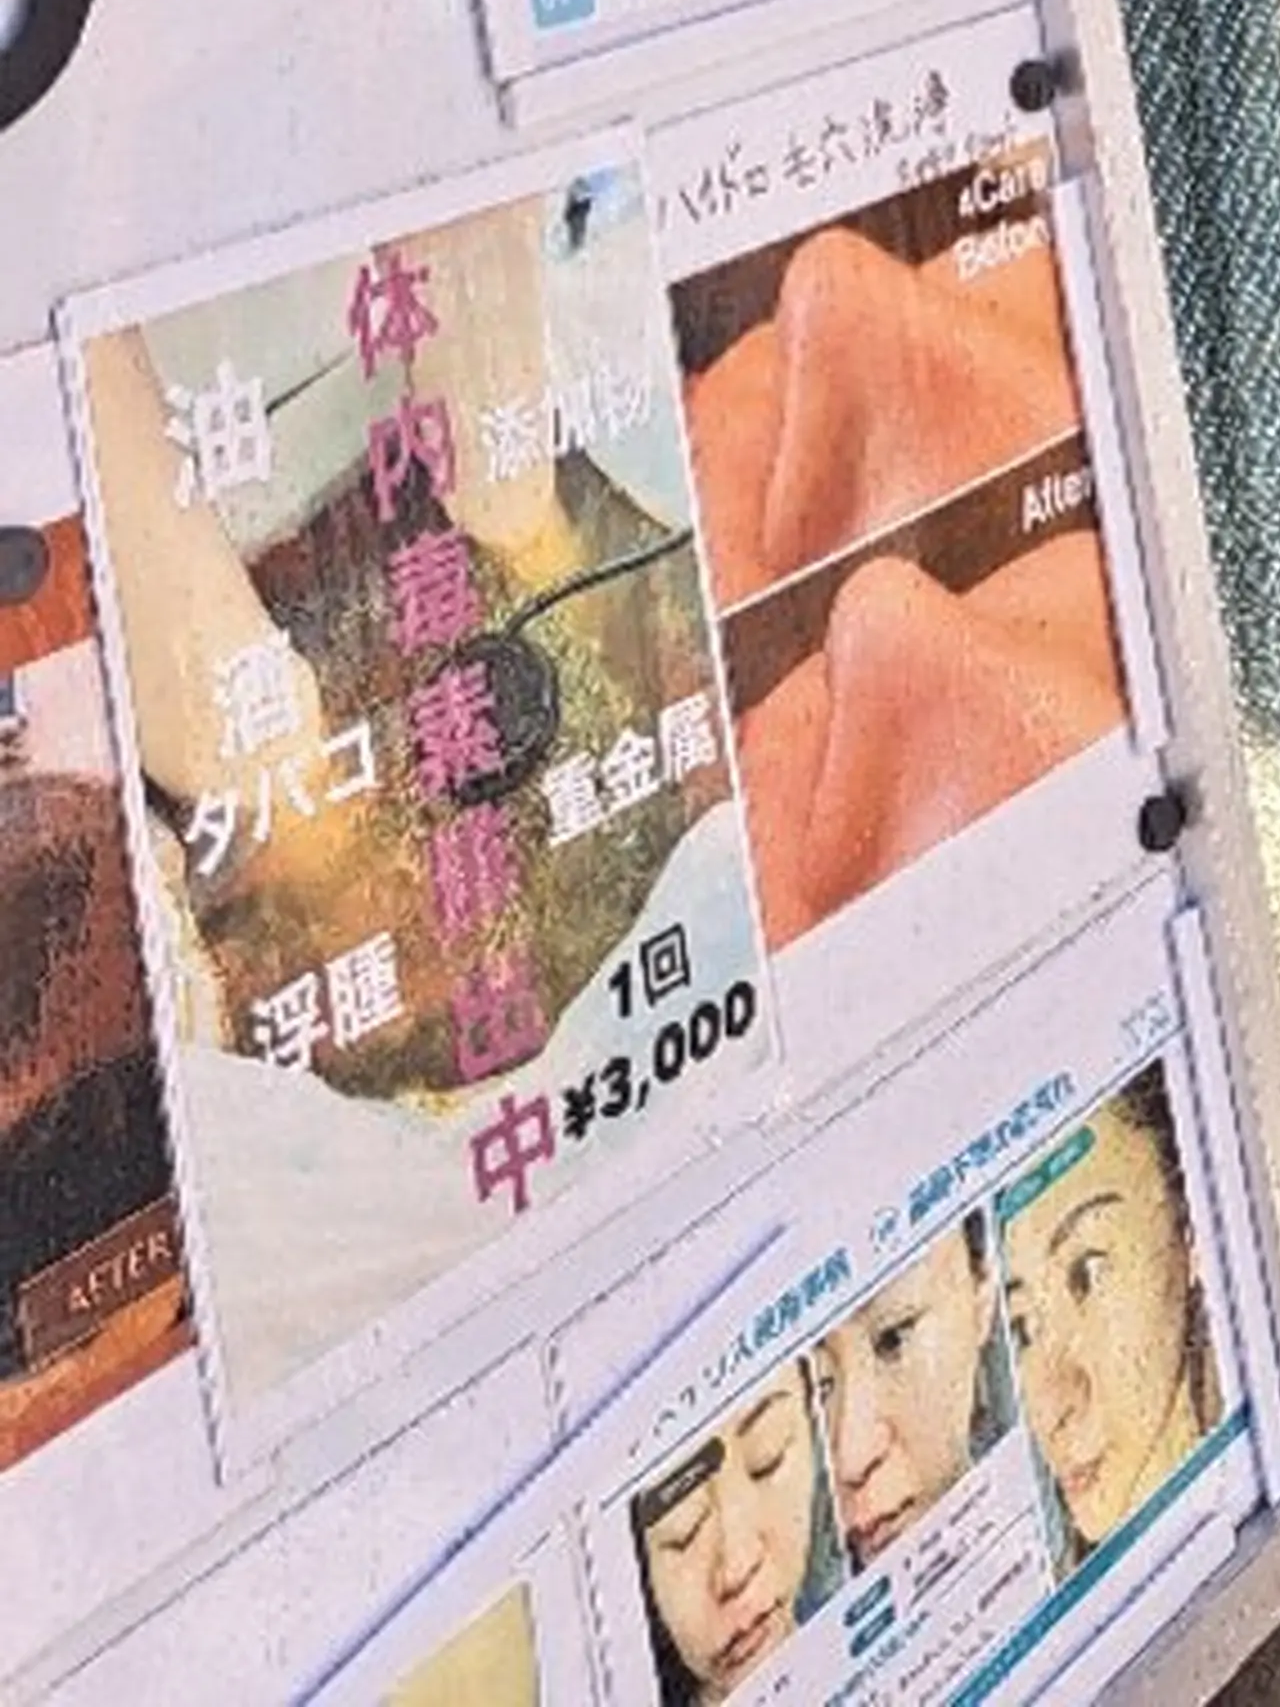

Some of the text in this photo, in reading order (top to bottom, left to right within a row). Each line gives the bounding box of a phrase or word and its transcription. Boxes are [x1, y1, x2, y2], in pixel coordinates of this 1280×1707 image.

[167, 359, 272, 509] 油
[185, 718, 377, 877] タバコ
[543, 692, 719, 848] 重金属
[252, 930, 403, 1073] 浮腫
[608, 922, 691, 1019] 1回
[562, 980, 757, 1142] ¥3,000
[63, 1230, 174, 1315] AFTER
